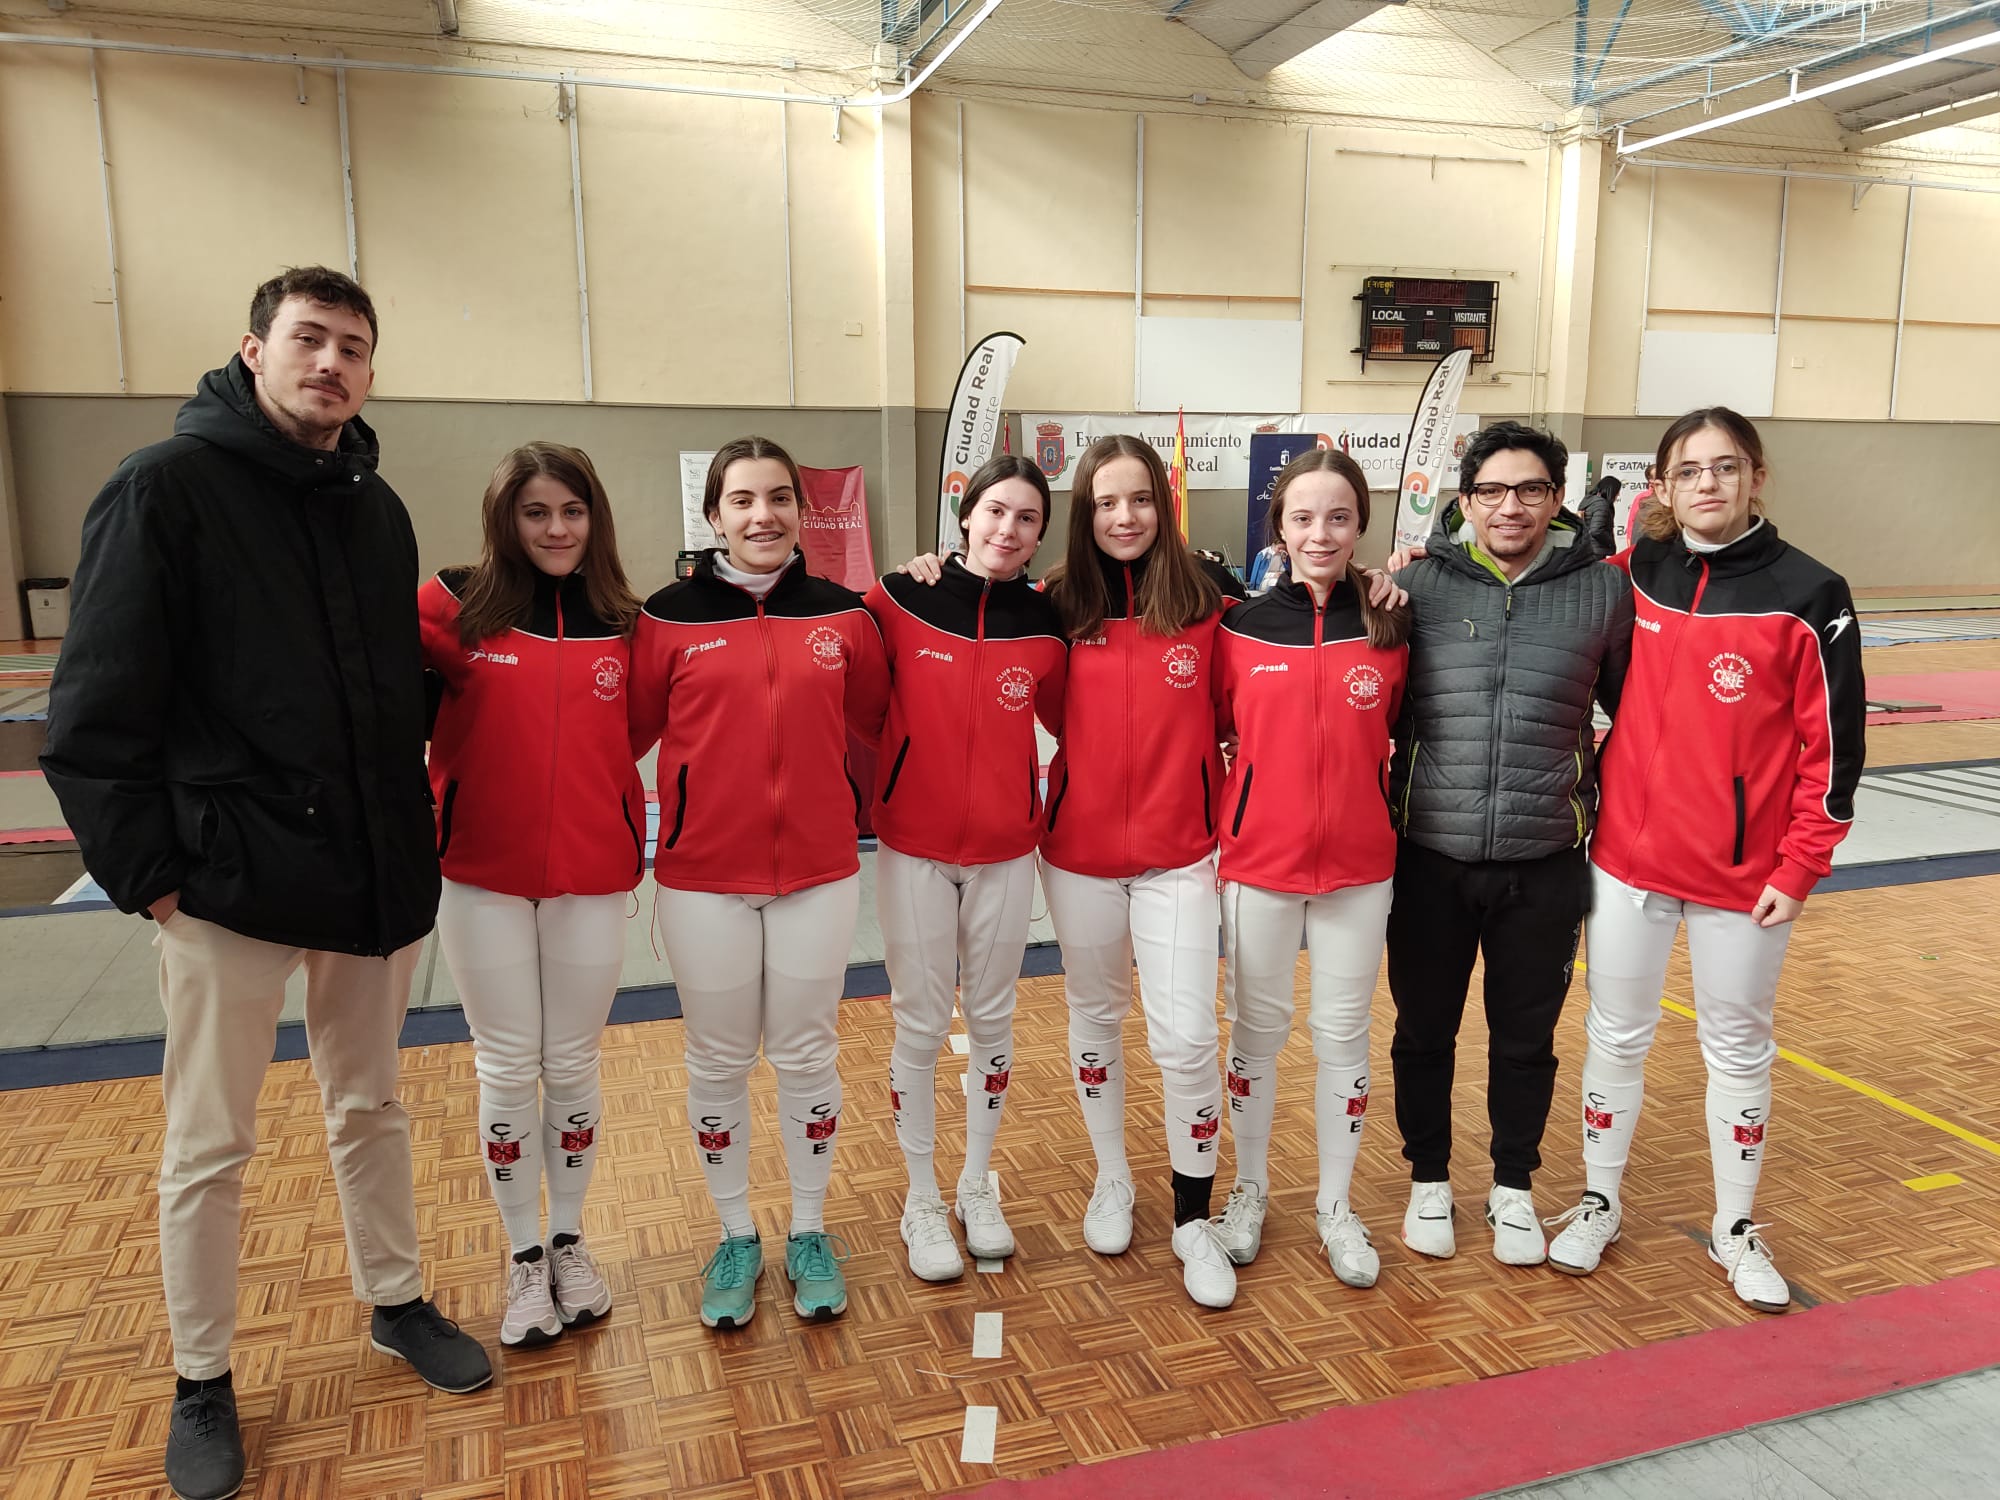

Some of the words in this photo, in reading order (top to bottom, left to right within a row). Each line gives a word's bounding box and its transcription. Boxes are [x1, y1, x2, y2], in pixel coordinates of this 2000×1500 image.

[1372, 310, 1406, 321] LOCAL
[1454, 312, 1487, 323] VISITANTE
[1416, 341, 1440, 351] PERIODO
[955, 395, 981, 465] Ciudad
[971, 346, 995, 390] Real
[1417, 406, 1439, 466] Ciudad
[1432, 365, 1450, 400] Real
[973, 396, 999, 469] Deporte
[1432, 404, 1454, 469] Deporte
[1137, 430, 1242, 451] Ayunamiento
[1338, 432, 1401, 449] Ciudad
[1185, 455, 1218, 472] Real
[803, 521, 836, 530] CIUDAD
[838, 521, 863, 530] REAL
[699, 636, 727, 652] rasán
[487, 653, 519, 666] rasán
[1708, 653, 1723, 668] CLUB
[990, 1054, 1006, 1067] C
[1081, 1052, 1100, 1063] C
[1231, 1056, 1247, 1071] C
[1353, 1076, 1367, 1090] C
[1085, 1087, 1101, 1099] E
[1587, 1091, 1607, 1106] C
[810, 1102, 832, 1115] C
[987, 1096, 1001, 1110] E
[1231, 1096, 1244, 1113] E
[567, 1111, 590, 1125] C
[1196, 1104, 1215, 1118] C
[1740, 1107, 1762, 1120] C
[700, 1116, 722, 1128] C
[1349, 1119, 1362, 1134] E
[489, 1123, 512, 1136] C
[1586, 1128, 1601, 1144] E
[813, 1142, 828, 1155] E
[1197, 1140, 1213, 1153] E
[565, 1154, 584, 1168] E
[706, 1152, 723, 1165] E
[1740, 1148, 1757, 1162] E
[495, 1167, 514, 1182] E
